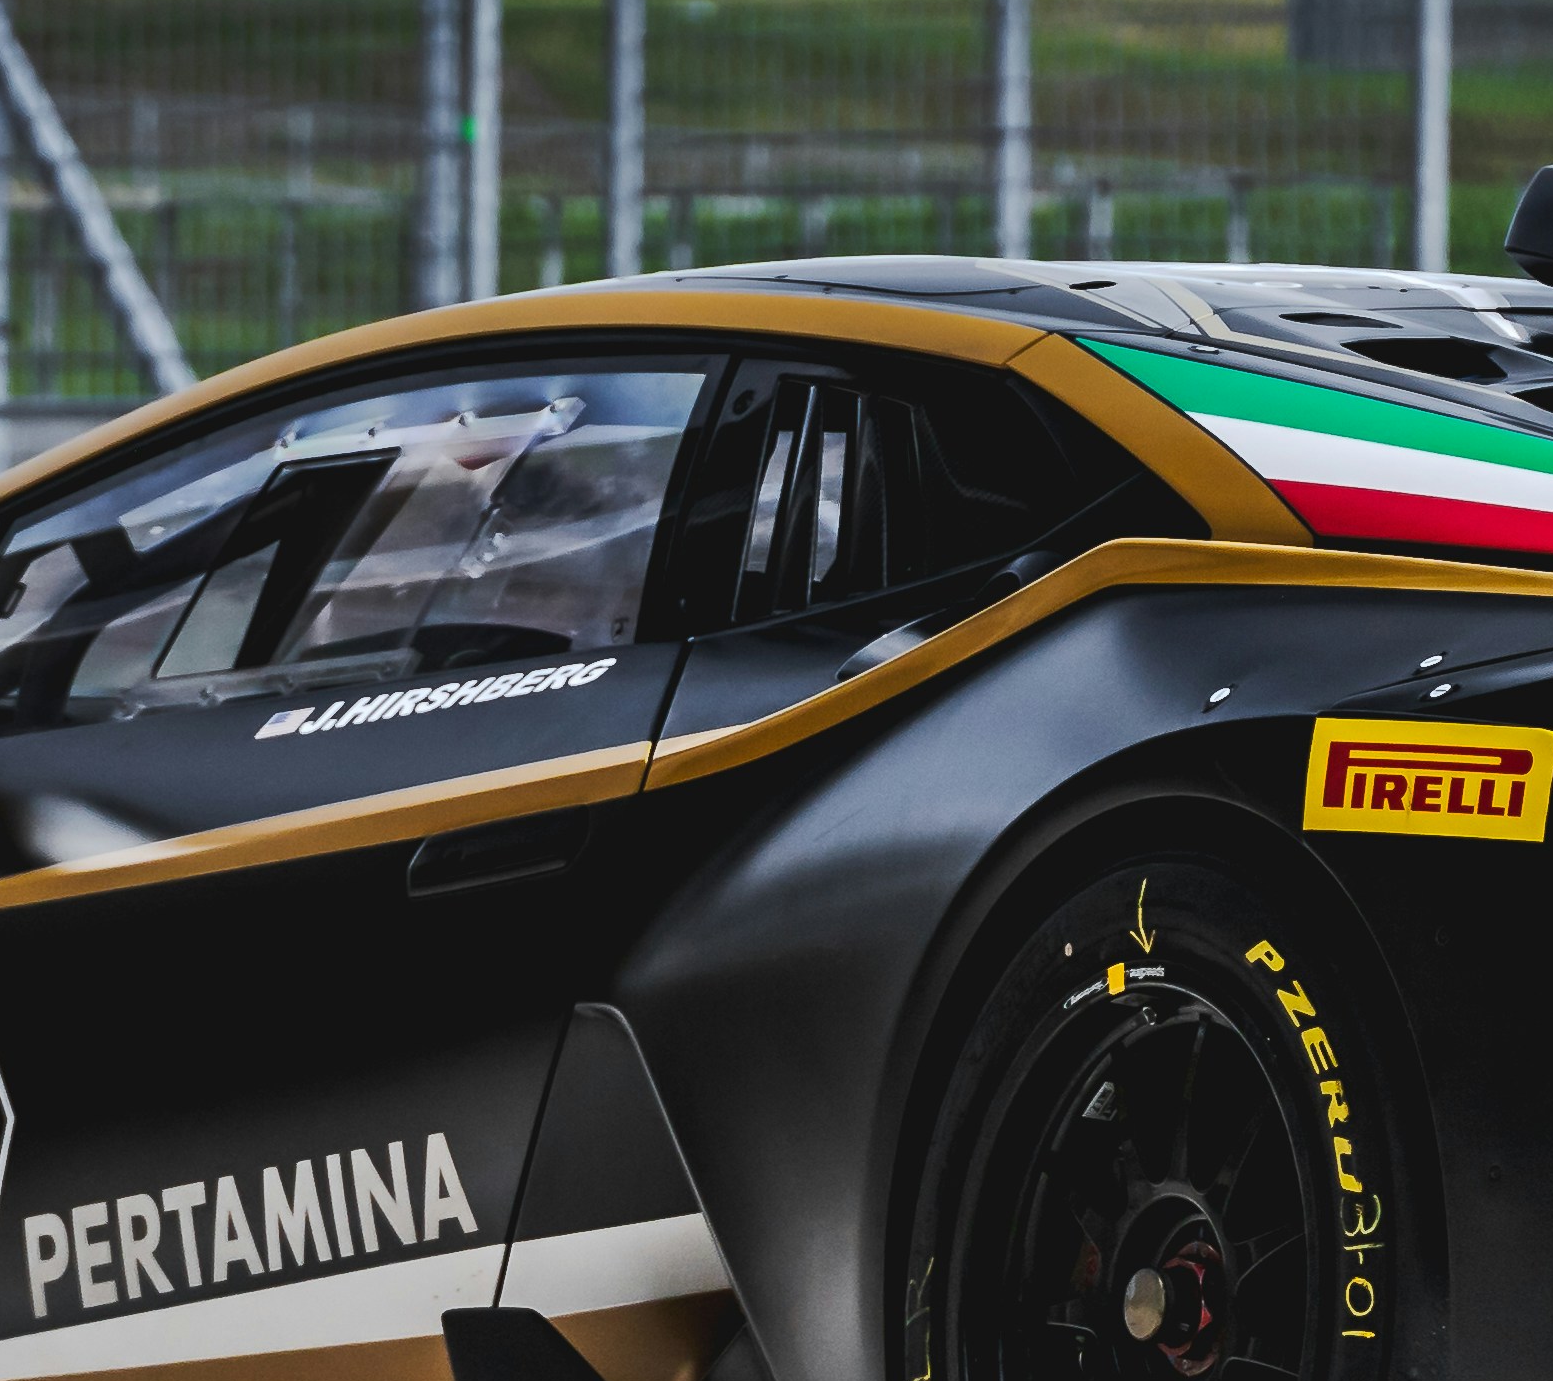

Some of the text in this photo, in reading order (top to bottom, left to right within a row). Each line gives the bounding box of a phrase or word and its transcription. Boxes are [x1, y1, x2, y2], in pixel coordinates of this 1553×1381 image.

[1322, 740, 1534, 818] PIRELLI
[1245, 940, 1285, 972] P
[24, 1132, 479, 1319] PERTAMINA
